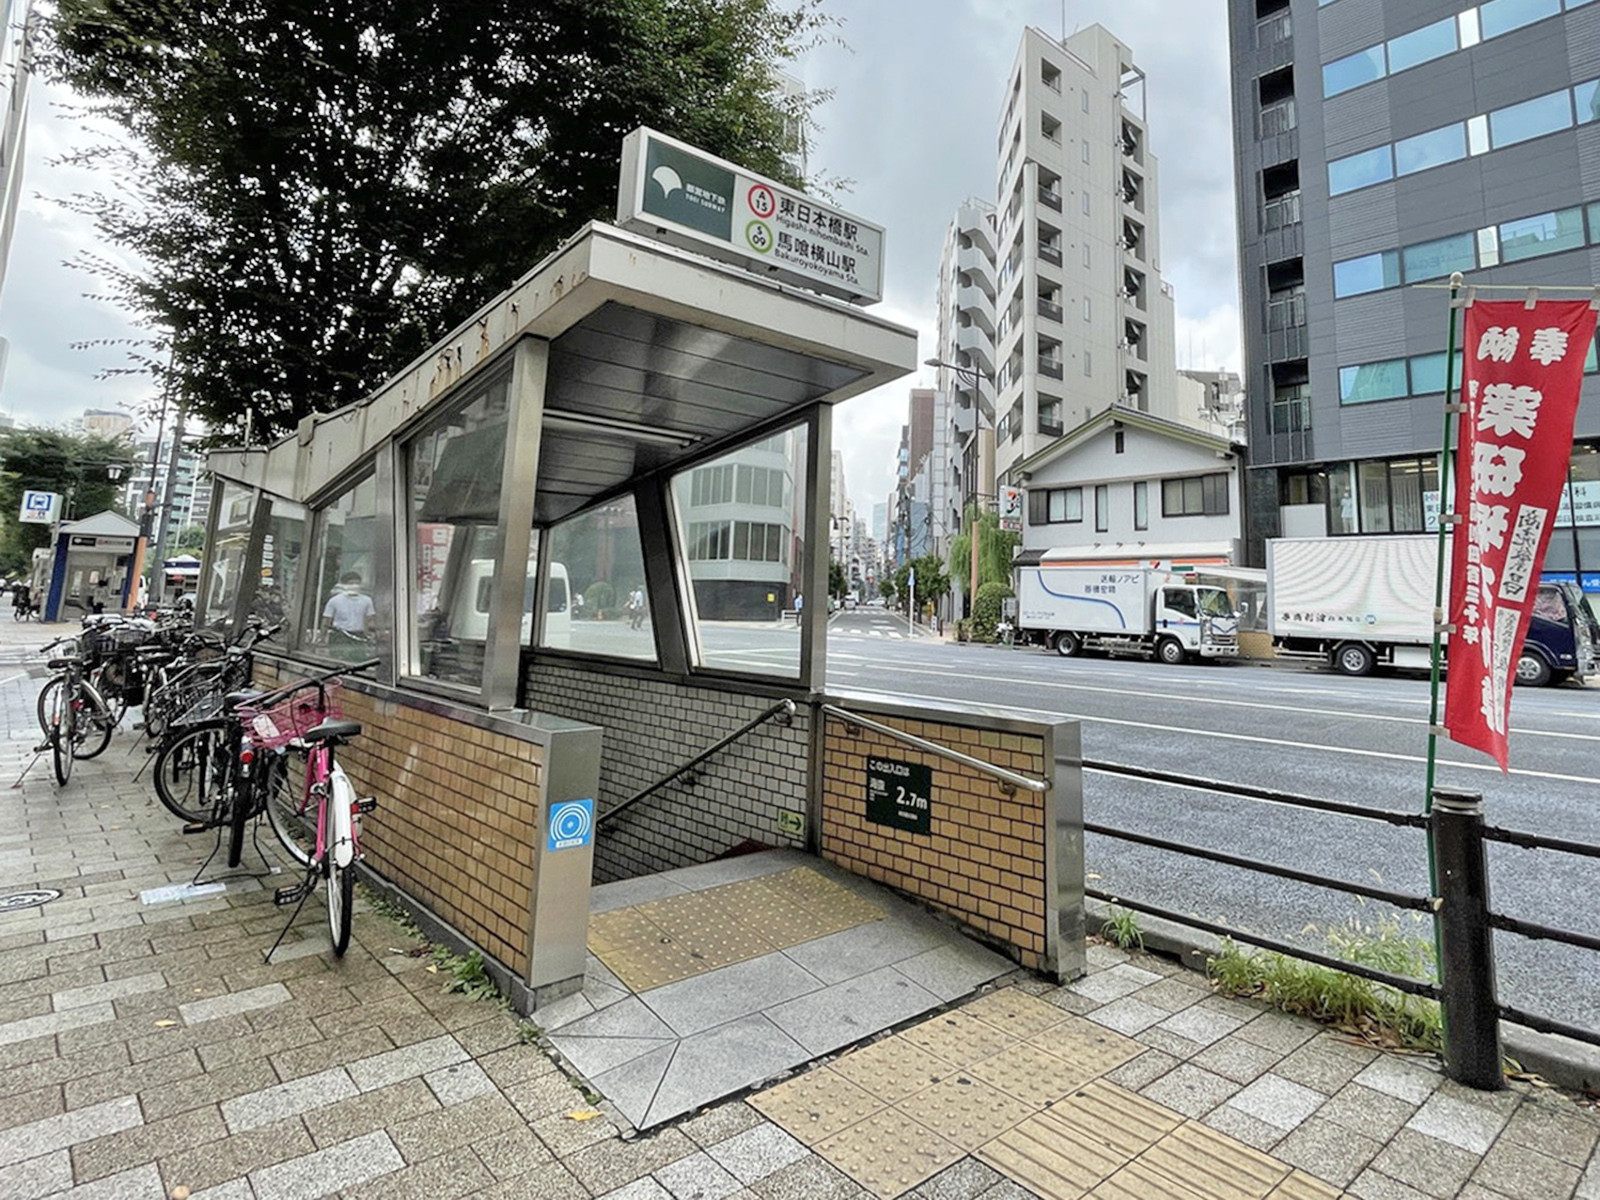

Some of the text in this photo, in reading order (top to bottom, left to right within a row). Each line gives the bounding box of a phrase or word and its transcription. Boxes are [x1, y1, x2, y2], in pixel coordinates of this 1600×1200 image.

[755, 199, 768, 213] 15
[757, 191, 767, 200] A
[755, 226, 763, 235] S
[775, 213, 855, 251] Higashi-nihombashi
[779, 198, 859, 242] 東日本橋駅
[752, 234, 767, 247] 09
[777, 231, 857, 275] 馬喰横山駅
[774, 248, 845, 282] Bakuroyokoyama
[896, 785, 928, 810] 2.7m
